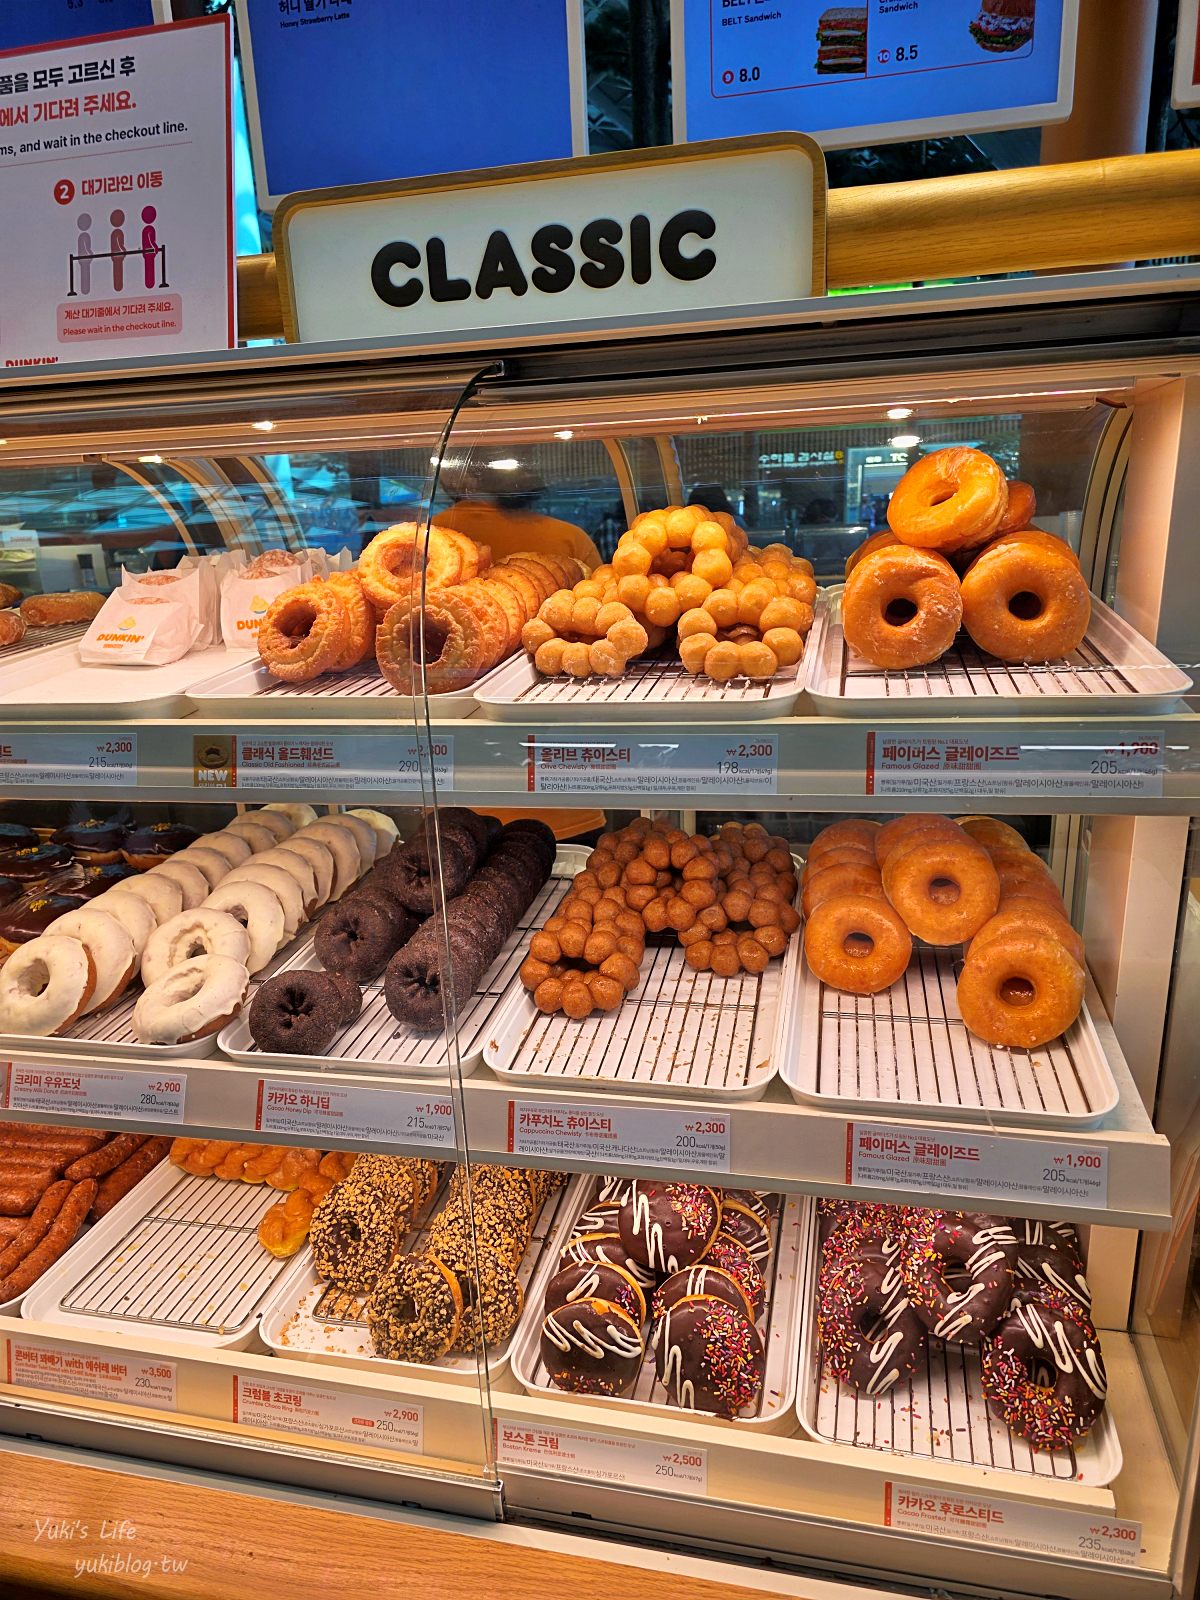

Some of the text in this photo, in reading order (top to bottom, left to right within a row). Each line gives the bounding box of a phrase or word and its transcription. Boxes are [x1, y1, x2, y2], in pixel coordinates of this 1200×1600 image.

[879, 2, 918, 14] Sandwich
[280, 21, 299, 29] Honey
[300, 16, 333, 26] Strawberry
[722, 11, 781, 26] BELT Sandwich
[896, 44, 918, 62] 8.5
[33, 67, 64, 90] 모두
[68, 58, 115, 84] 고르신
[120, 56, 135, 76] 후
[740, 67, 760, 82] 8.0
[33, 97, 78, 122] 기다려
[83, 90, 137, 116] 주세요.
[20, 140, 40, 153] and
[43, 136, 67, 149] wait
[70, 134, 81, 146] in
[83, 133, 103, 145] the
[105, 123, 160, 142] checkout
[163, 121, 188, 134] line.
[82, 171, 163, 196] 대기라인 이동
[370, 208, 717, 308] CLASSIC
[65, 309, 80, 320] 계산
[122, 304, 146, 315] 기다려
[148, 302, 174, 313] 주세요.
[63, 328, 86, 338] Please
[87, 325, 103, 335] wait
[104, 325, 111, 333] in
[112, 324, 124, 332] the
[126, 321, 160, 331] checkout
[96, 633, 144, 643] DUNKIN'
[242, 747, 334, 761] 클래식 올드훼션드
[541, 747, 631, 763] 올리브 츄이스티
[882, 745, 1020, 762] 페이머스 글레이즈드
[241, 761, 262, 769] Classic
[263, 761, 274, 769] Old
[274, 761, 305, 769] Fashioned
[881, 762, 911, 770] Famous
[912, 762, 940, 770] Glazed
[198, 769, 228, 782] NEW
[14, 1074, 42, 1087] 크리미
[44, 1076, 81, 1090] 우유도넛
[267, 1091, 298, 1106] 카카오
[300, 1094, 330, 1110] 하니딥
[285, 1106, 302, 1114] Honey
[302, 1107, 312, 1116] Dip
[519, 1113, 611, 1132] 카푸치노 츄이스티
[519, 1126, 555, 1136] Cappuccino
[555, 1129, 582, 1138] Chewisty
[858, 1150, 885, 1160] Famous
[886, 1154, 910, 1162] Glazed
[859, 1136, 980, 1161] 페이머스 글레이즈드
[65, 1358, 84, 1370] with
[111, 1364, 127, 1377] 버터
[273, 1391, 302, 1407] 초코링
[502, 1430, 535, 1446] 보스톤
[537, 1435, 559, 1450] 크림
[502, 1442, 542, 1454] Boston Kreme
[897, 1495, 936, 1512] 카카오
[939, 1502, 1005, 1524] 후로스티드
[897, 1508, 947, 1522] Cacao Frosted
